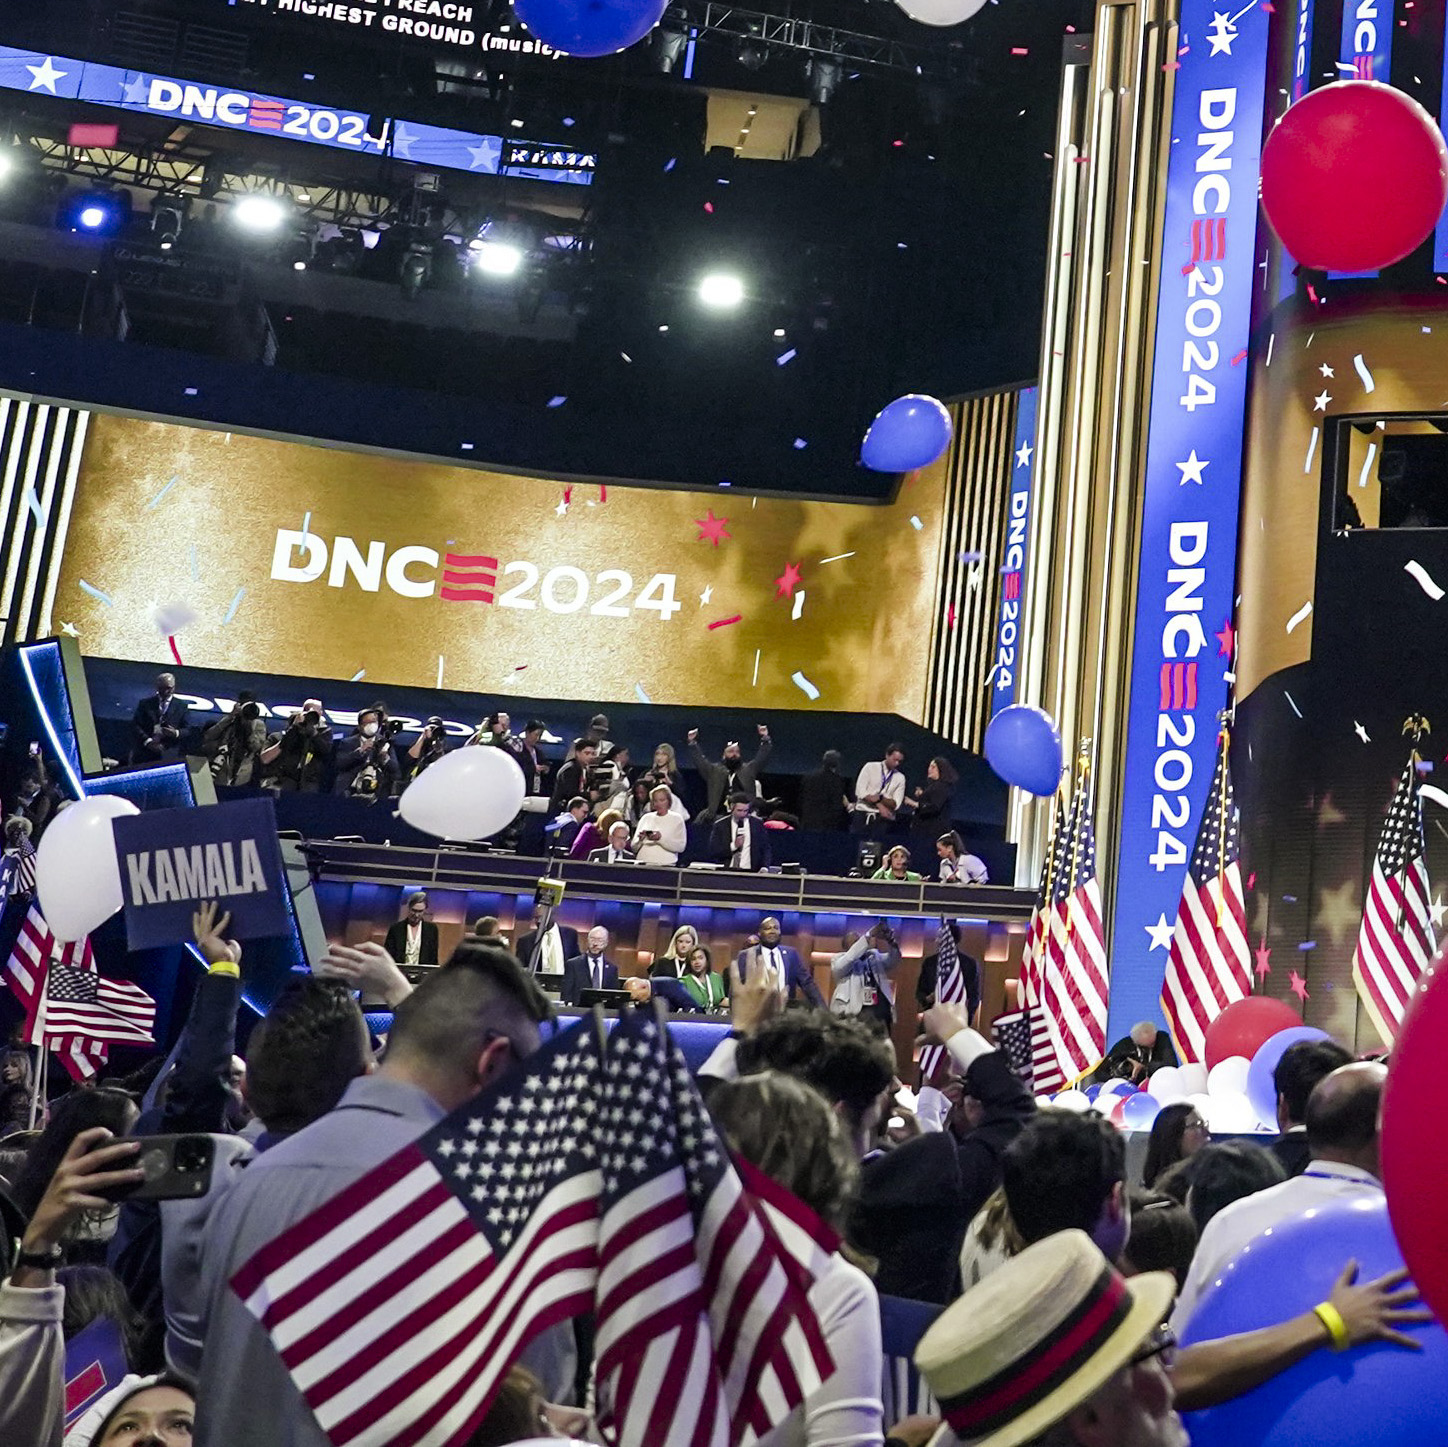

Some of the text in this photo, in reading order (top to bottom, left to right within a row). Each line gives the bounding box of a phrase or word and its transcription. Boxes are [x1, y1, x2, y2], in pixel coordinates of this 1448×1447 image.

[381, 13, 475, 46] GROUND
[1178, 261, 1225, 413] 2024
[497, 559, 682, 621] 2024
[996, 600, 1020, 692] 2024
[1149, 713, 1197, 872] 2024
[126, 838, 268, 906] KAMALA
